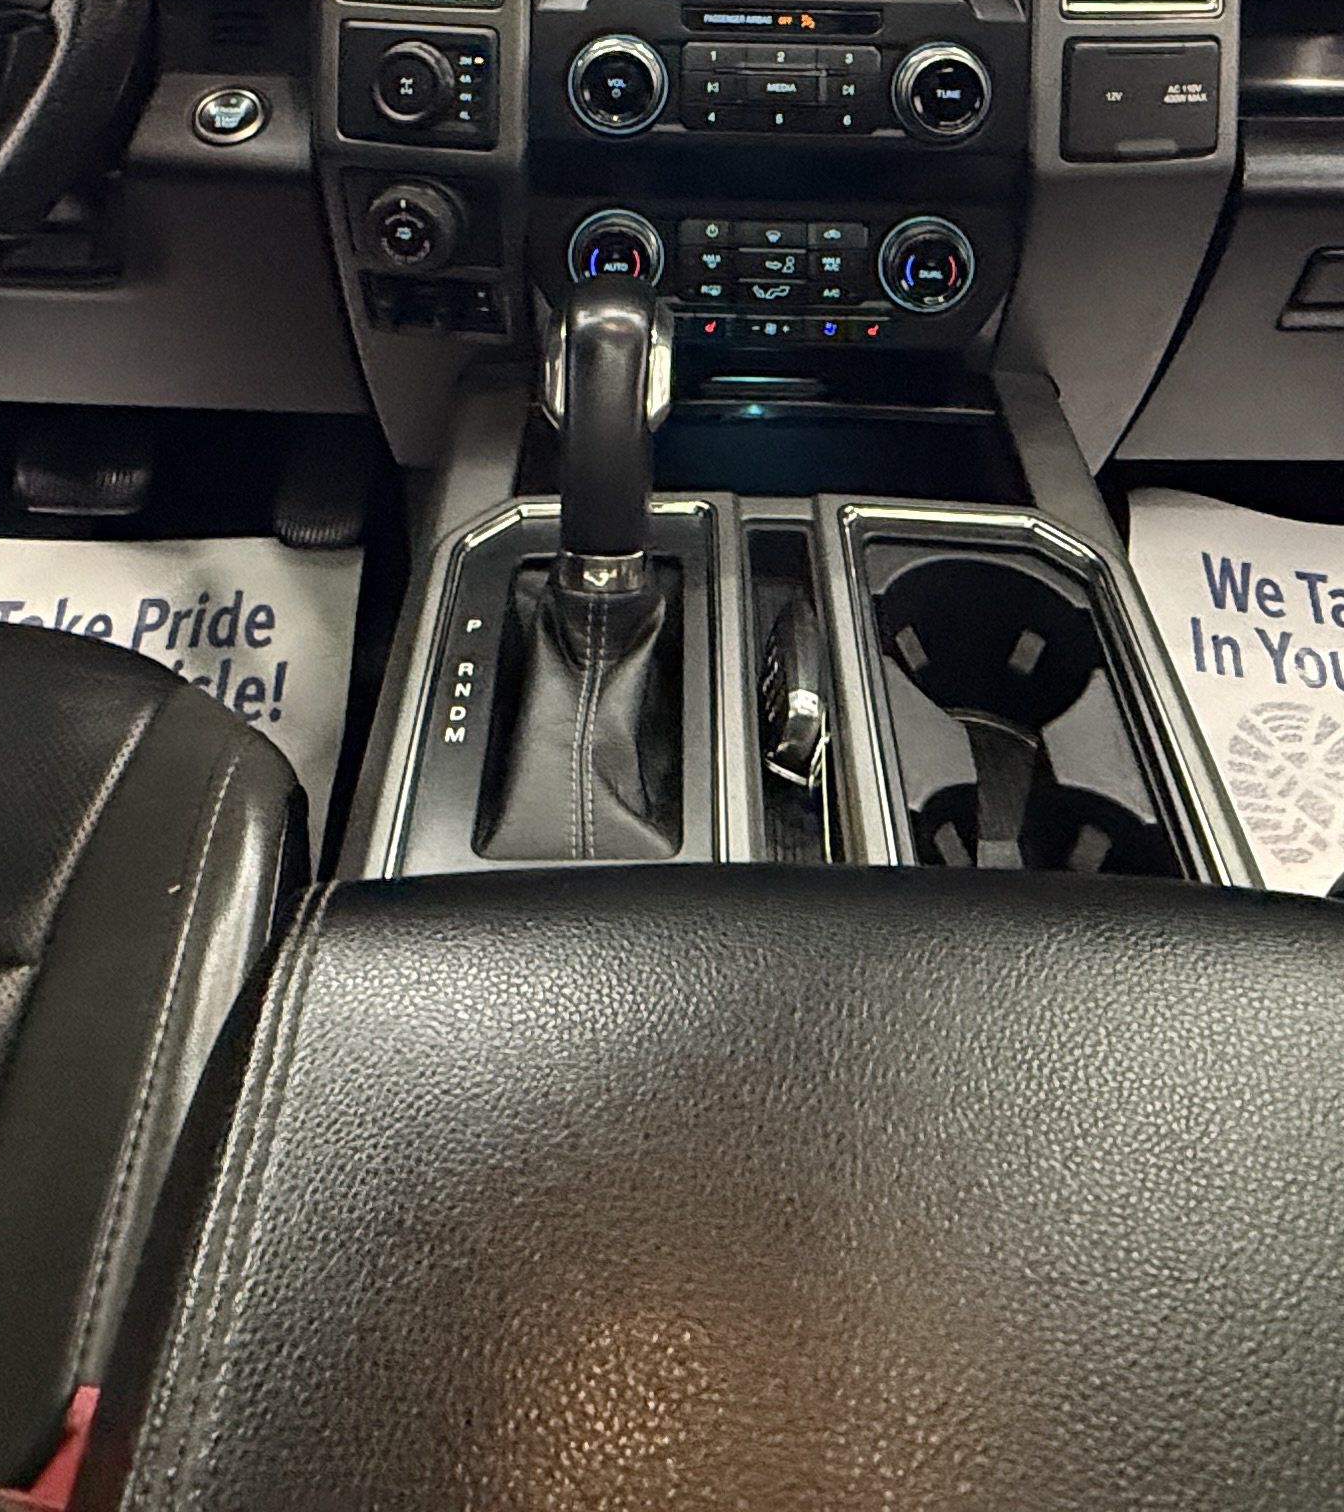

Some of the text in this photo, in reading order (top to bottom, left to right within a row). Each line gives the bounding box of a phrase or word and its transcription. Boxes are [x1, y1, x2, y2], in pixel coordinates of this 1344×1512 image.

[710, 51, 717, 62] 1
[777, 51, 786, 63] 2
[845, 53, 853, 64] 3
[766, 82, 797, 93] MEDIA
[1106, 91, 1123, 101] 12V
[708, 112, 716, 122] 4
[775, 113, 784, 124] 5
[843, 114, 852, 126] 6
[603, 262, 629, 272] AUTO
[1201, 551, 1287, 619] We
[131, 589, 276, 651] Pride
[1191, 617, 1245, 679] In
[444, 619, 482, 743] P R N D M
